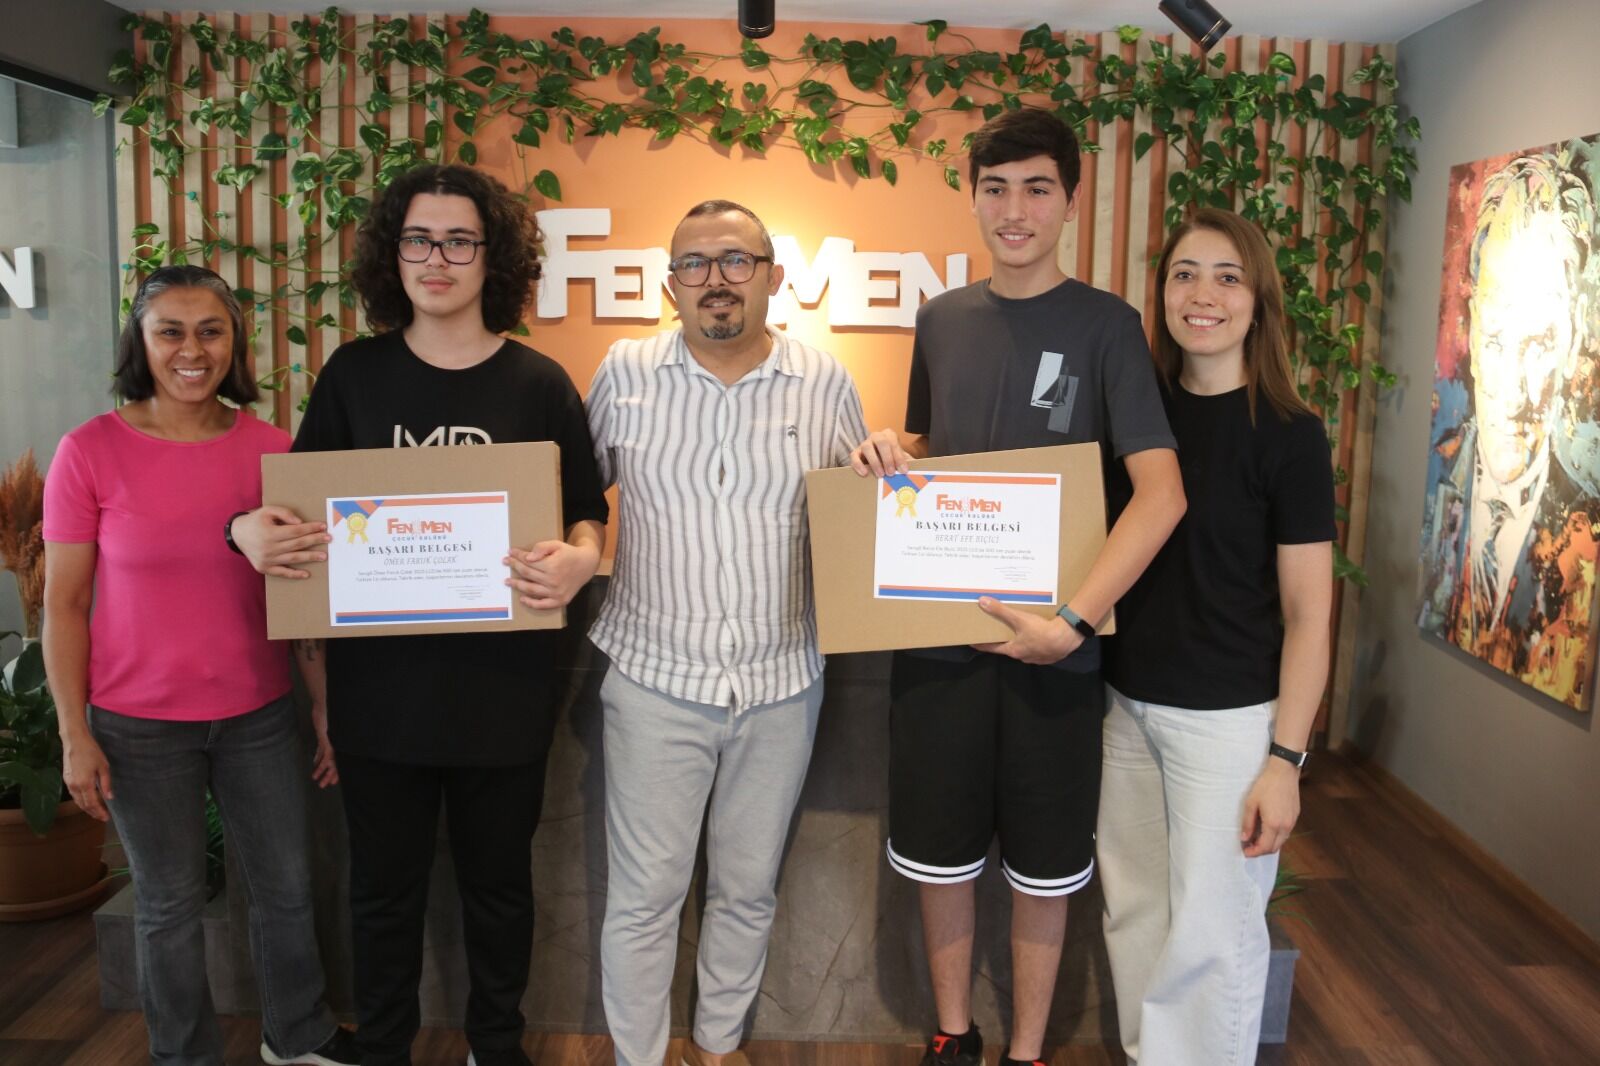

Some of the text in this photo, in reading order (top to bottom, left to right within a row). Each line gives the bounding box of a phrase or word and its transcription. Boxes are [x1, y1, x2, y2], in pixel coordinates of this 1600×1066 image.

[536, 208, 967, 327] FENMEN
[916, 521, 1020, 532] BAŞARI BELGESİ
[368, 541, 473, 556] BAŞARI BELGESİ
